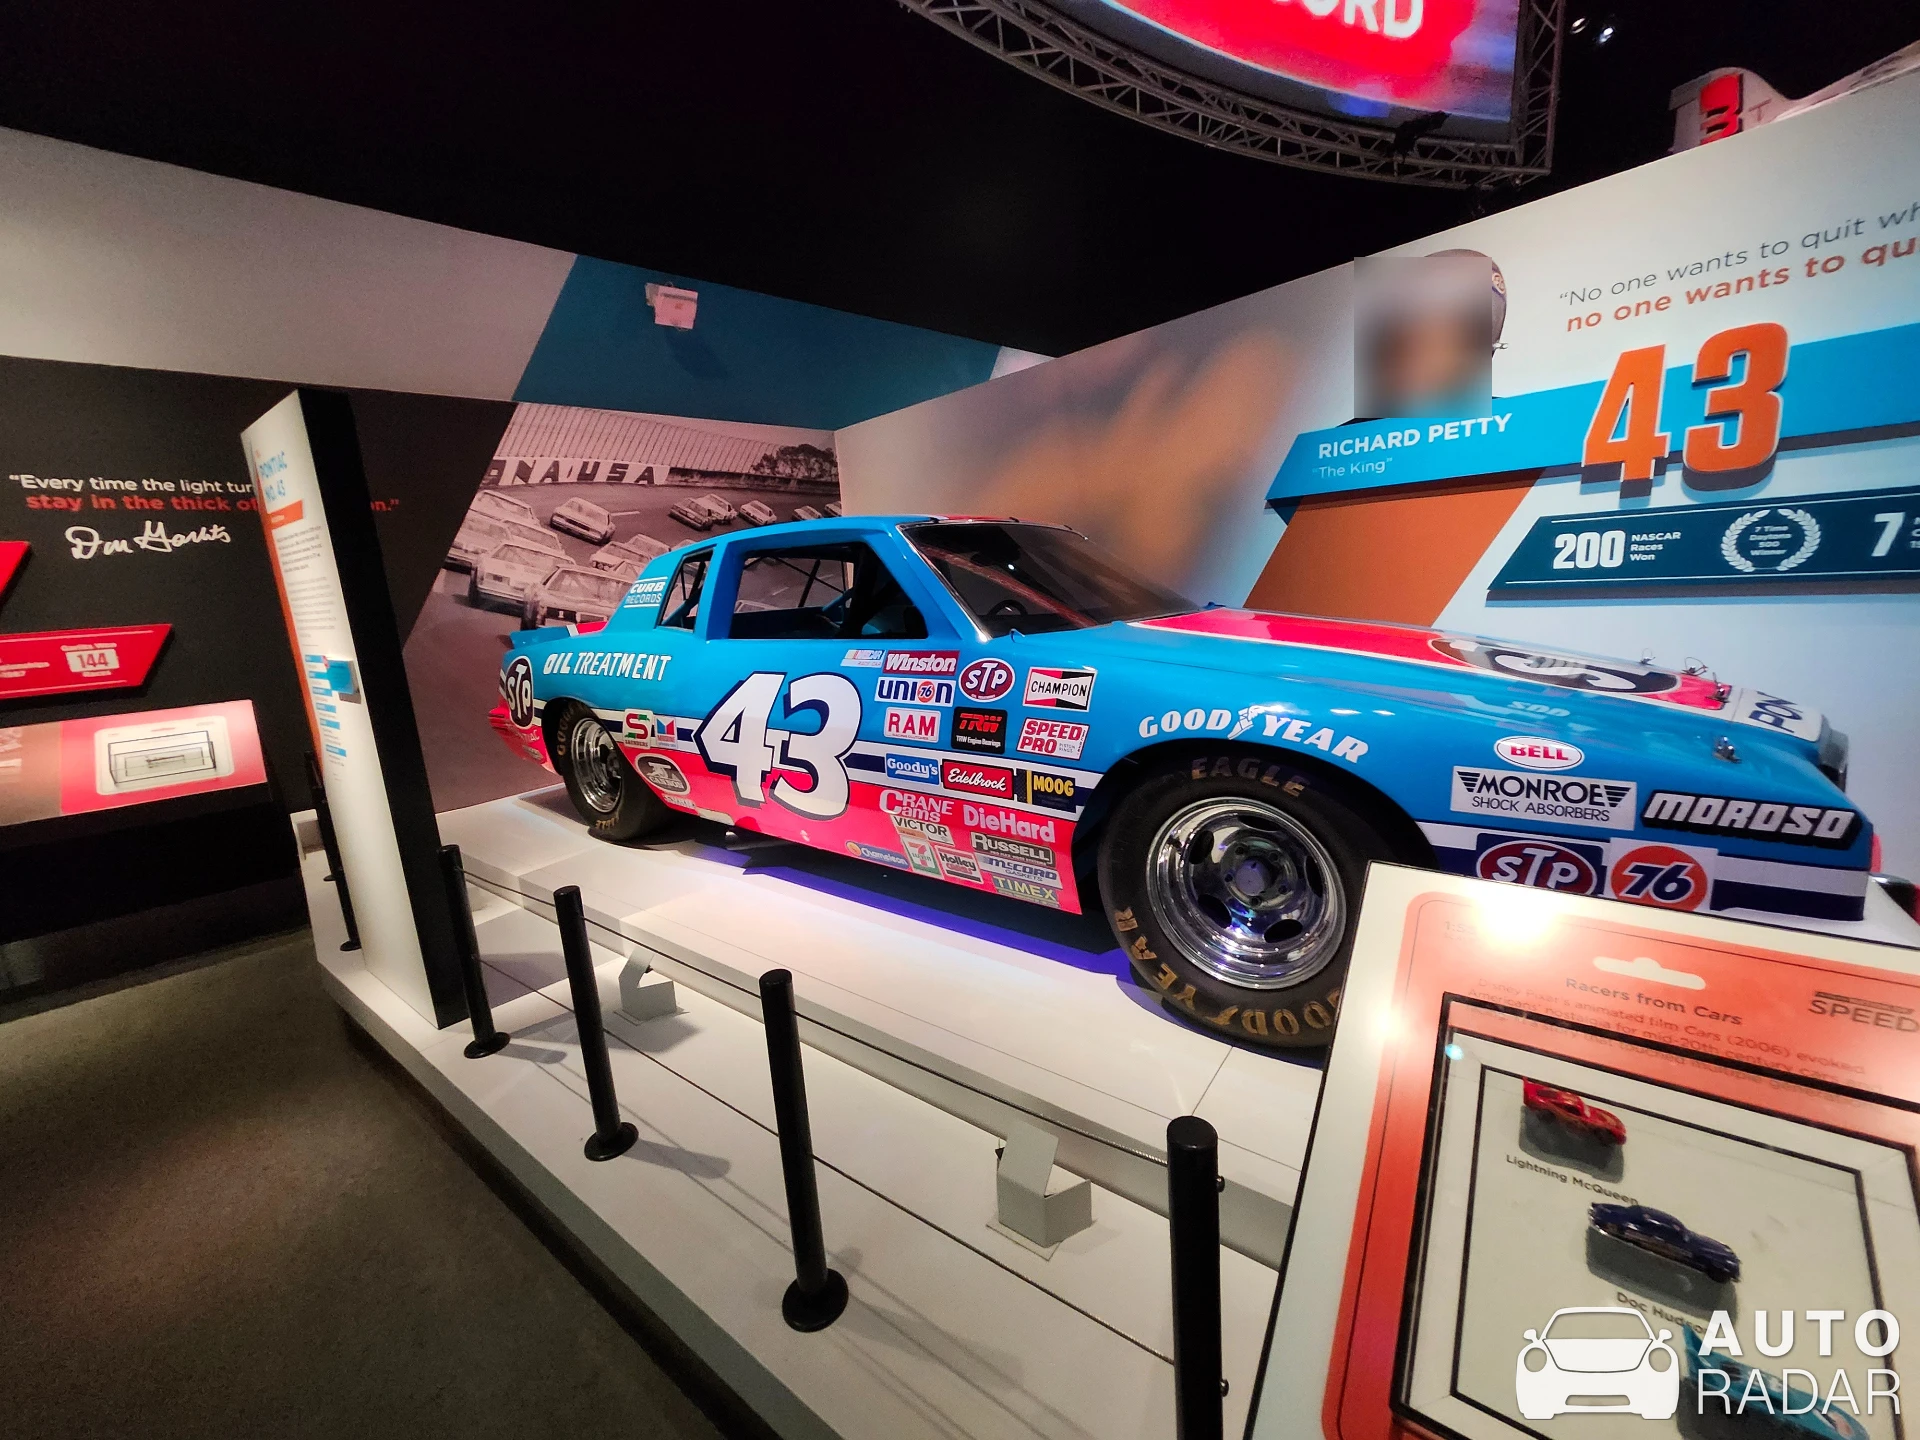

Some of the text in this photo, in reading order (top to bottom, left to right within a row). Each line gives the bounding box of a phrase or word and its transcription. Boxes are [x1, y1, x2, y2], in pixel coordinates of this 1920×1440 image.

[1611, 272, 1657, 296] one
[1667, 250, 1748, 283] wants
[1760, 238, 1789, 259] to
[1801, 216, 1866, 250] quit
[1566, 311, 1602, 332] no
[1613, 295, 1672, 321] one
[1685, 265, 1790, 305] wants
[1804, 253, 1845, 277] to
[1581, 322, 1788, 482] 43
[1318, 413, 1513, 459] RICHARD PETTY
[89, 477, 138, 491] time
[142, 478, 176, 492] the
[180, 479, 222, 494] light
[577, 461, 655, 485] USA
[26, 494, 83, 512] stay
[91, 494, 118, 510] in
[122, 496, 165, 510] the
[171, 496, 231, 511] thick
[1630, 541, 1663, 552] Races
[1871, 511, 1906, 557] 7
[1552, 530, 1681, 569] 200 NASCAR
[1630, 552, 1655, 561] Won
[626, 593, 663, 604] RECORDS
[630, 581, 666, 594] CURB
[76, 652, 109, 668] 144
[543, 652, 672, 681] OIL TREATMENT
[886, 654, 957, 672] Winston
[966, 663, 1007, 692] STP
[1031, 681, 1088, 697] CHAMPION
[507, 664, 531, 719] STP
[888, 713, 936, 737] RAM
[959, 713, 1002, 733] TRW
[1025, 721, 1083, 741] SPEED
[1139, 708, 1369, 764] GOOD YEAR
[696, 672, 861, 817] 43
[1019, 736, 1057, 754] PRO
[1510, 744, 1570, 761] BELL
[887, 758, 938, 777] Goody's
[947, 768, 1006, 791] Edelbrock
[1192, 756, 1310, 797] EAGLE
[1034, 775, 1074, 797] MOOG
[1477, 775, 1605, 807] MONROE
[1472, 796, 1610, 822] SHOCK ABSORBERS
[1643, 792, 1856, 839] MOROSO
[893, 816, 947, 837] VICTOR
[963, 804, 1055, 843] DieHard
[971, 831, 1050, 861] RUSSELL
[940, 853, 976, 872] Holley
[1492, 847, 1580, 889] STP
[992, 875, 1056, 902] TIMEX
[1619, 862, 1695, 904] 76
[1566, 978, 1743, 1025] Racers from Cars
[1808, 1000, 1920, 1033] SPEED
[1649, 1016, 1679, 1031] film
[1684, 1025, 1721, 1042] Cars
[1727, 1036, 1790, 1058] (2006)
[1506, 1155, 1640, 1205] Lightning McQueen
[1617, 1292, 1648, 1313] Doc
